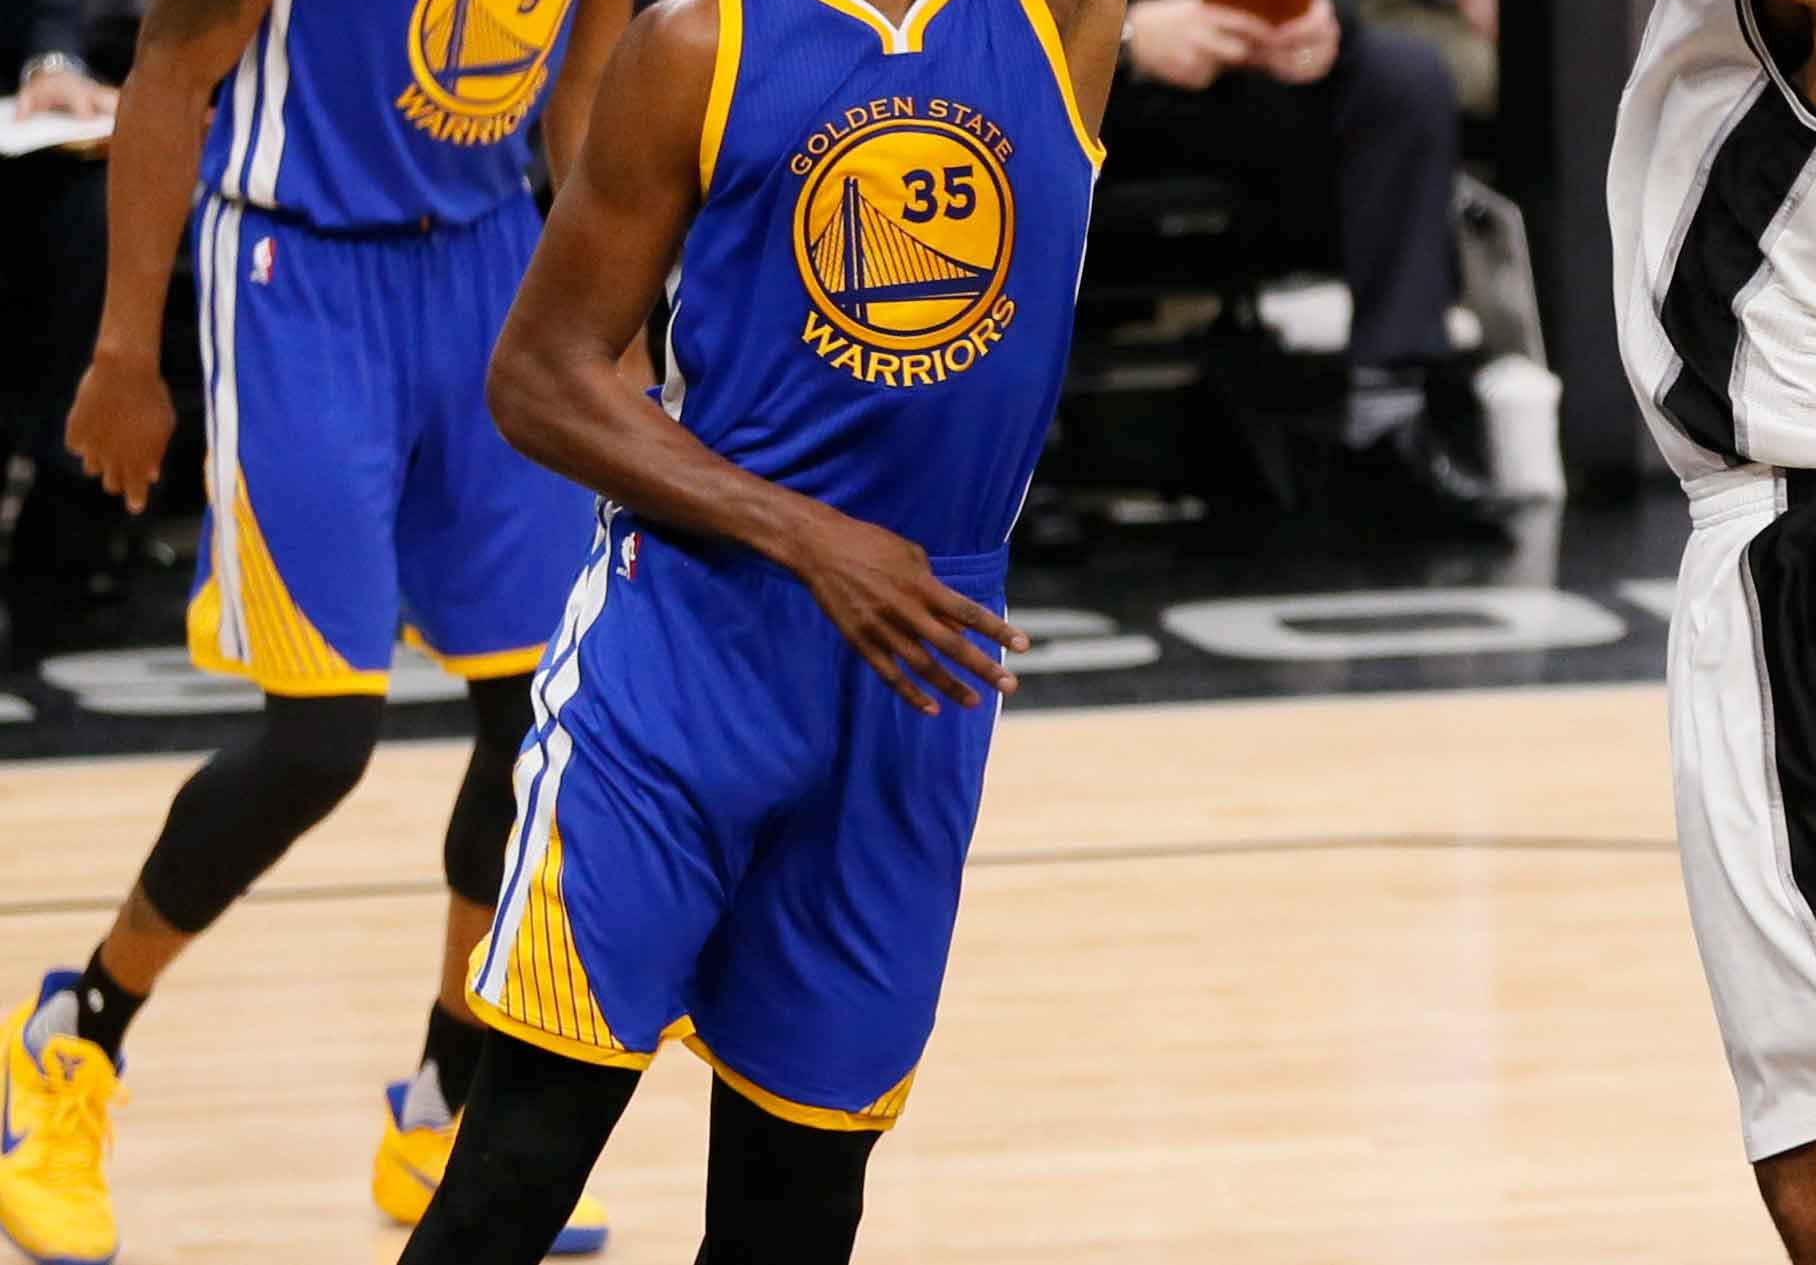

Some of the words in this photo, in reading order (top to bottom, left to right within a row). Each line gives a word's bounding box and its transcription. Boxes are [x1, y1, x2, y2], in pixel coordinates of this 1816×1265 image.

[789, 95, 915, 176] GOLDEN
[927, 98, 1014, 164] STATE
[901, 164, 977, 224] 35
[801, 292, 1017, 388] WARRIORS
